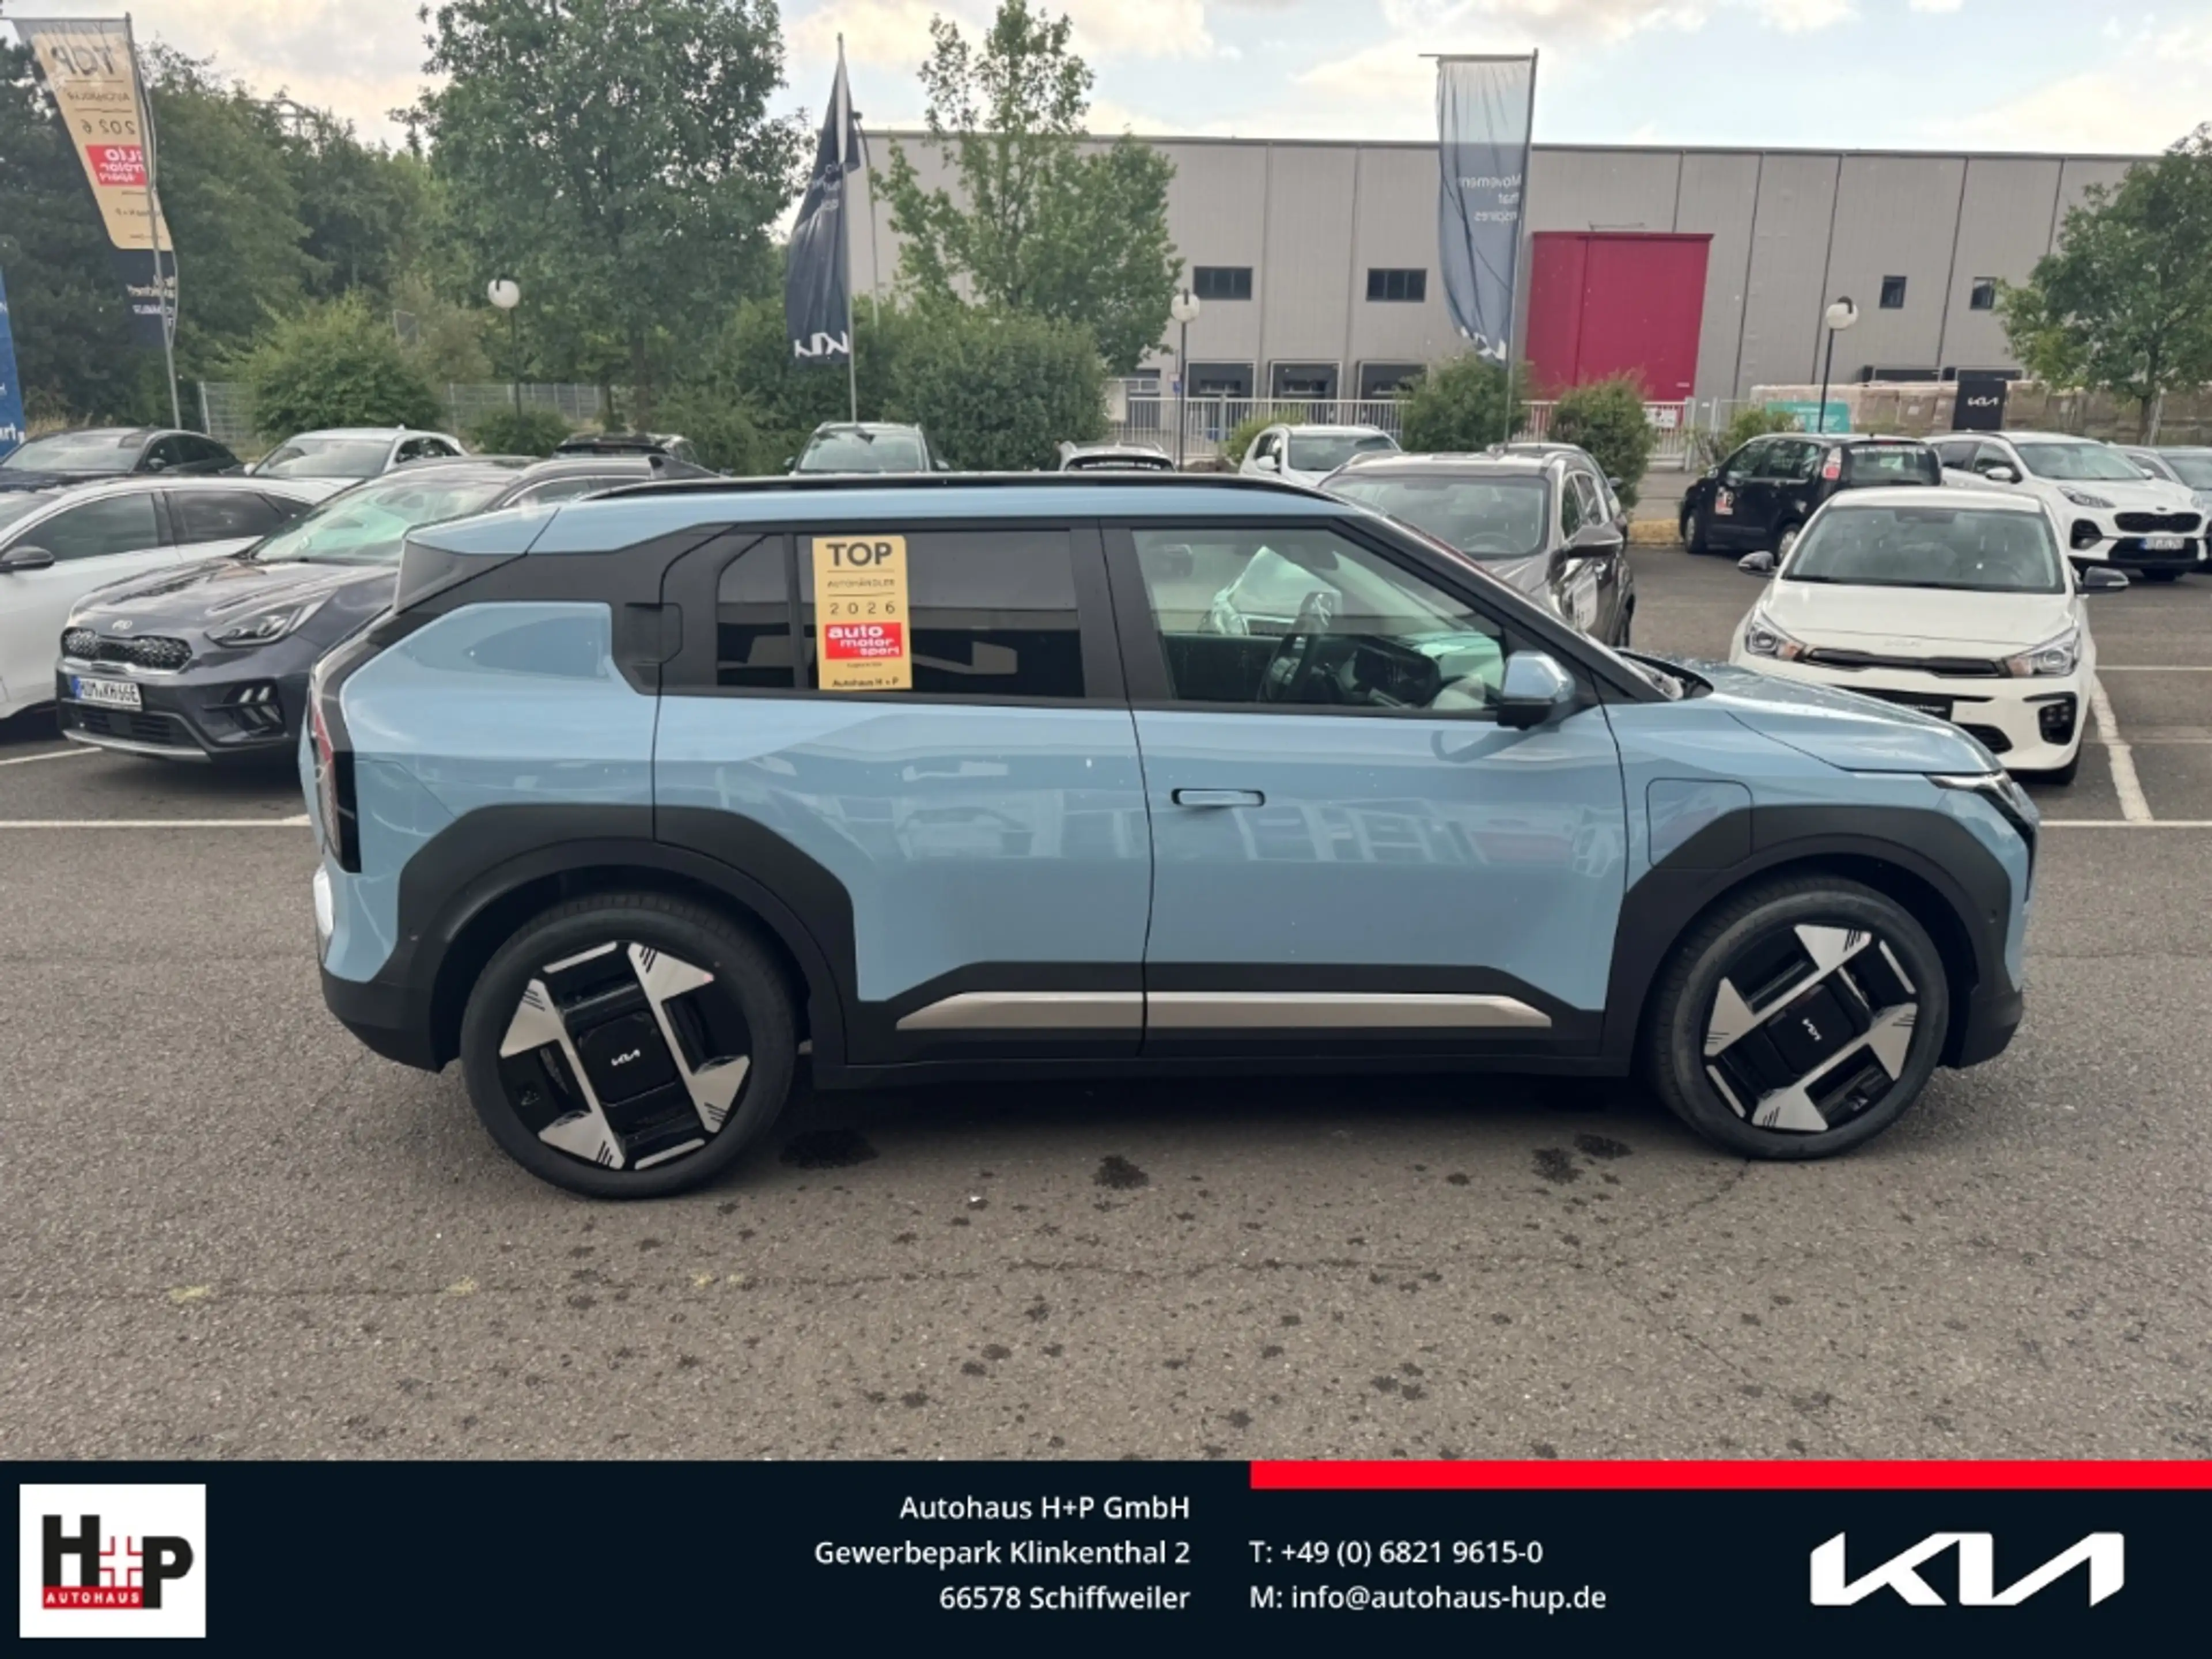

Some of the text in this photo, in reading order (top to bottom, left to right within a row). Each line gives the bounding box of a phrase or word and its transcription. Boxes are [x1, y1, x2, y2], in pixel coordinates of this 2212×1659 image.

[1968, 397, 1999, 406] KIA
[826, 542, 892, 566] TOP
[830, 601, 895, 615] 2026
[828, 625, 884, 639] auto
[839, 638, 895, 647] motor
[859, 646, 900, 657] sport
